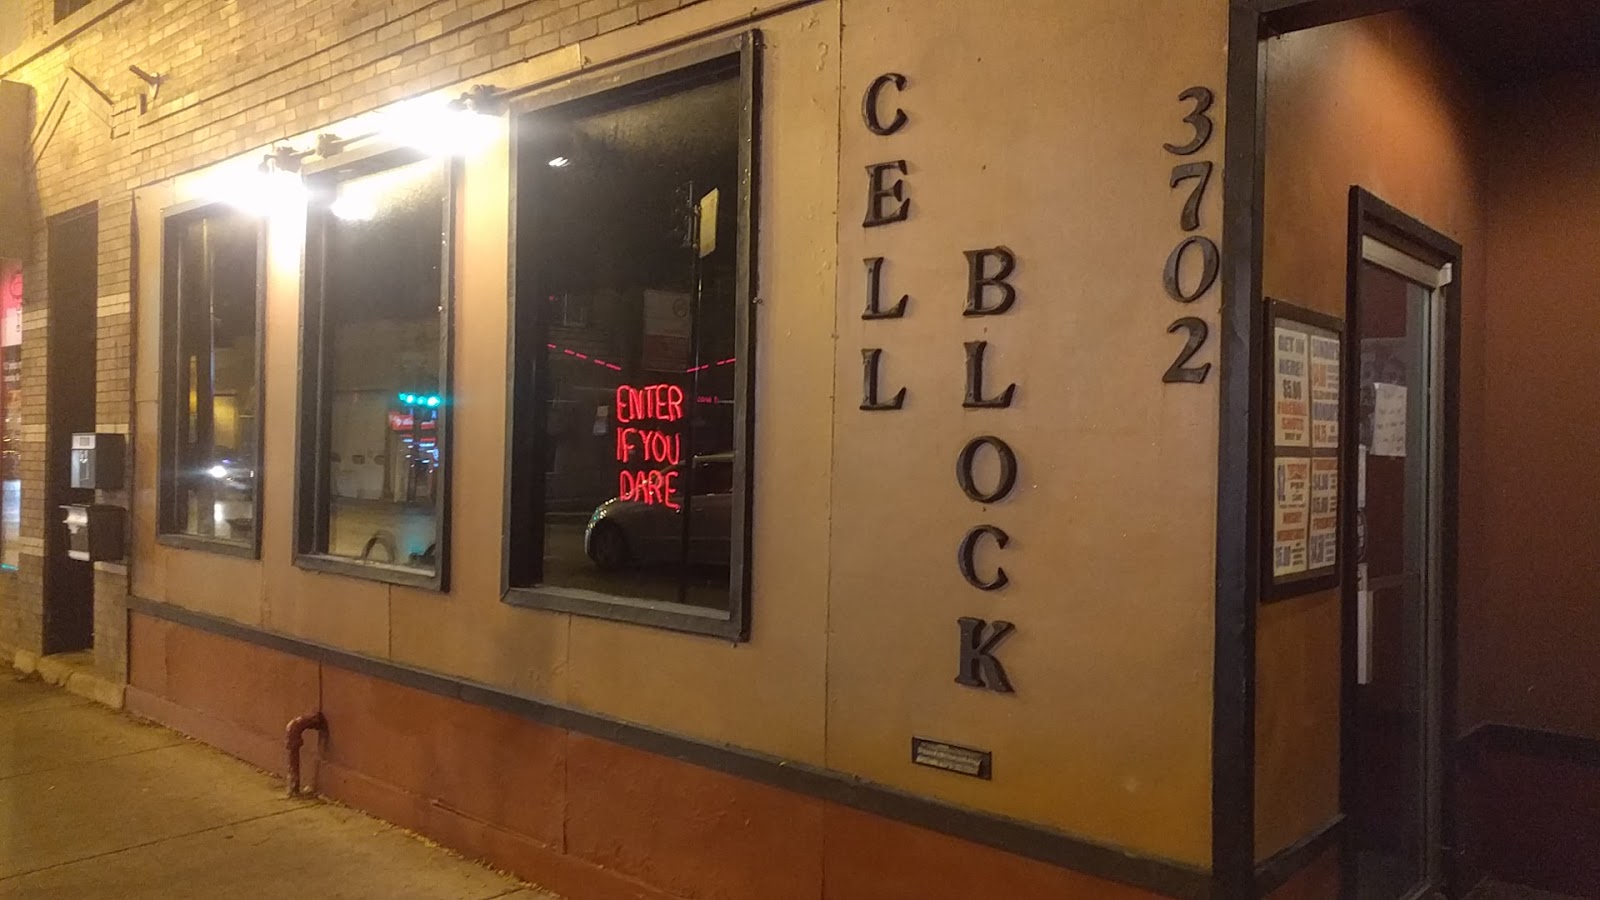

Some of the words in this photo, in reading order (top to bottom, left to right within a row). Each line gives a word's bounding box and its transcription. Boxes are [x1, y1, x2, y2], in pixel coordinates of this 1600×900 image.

[861, 72, 911, 411] CELL
[1162, 86, 1219, 384] 3702
[616, 384, 683, 422] ENTER
[616, 427, 637, 463] IF
[638, 430, 680, 465] YOU
[955, 245, 1018, 694] BLOCK
[619, 469, 681, 508] DARE
